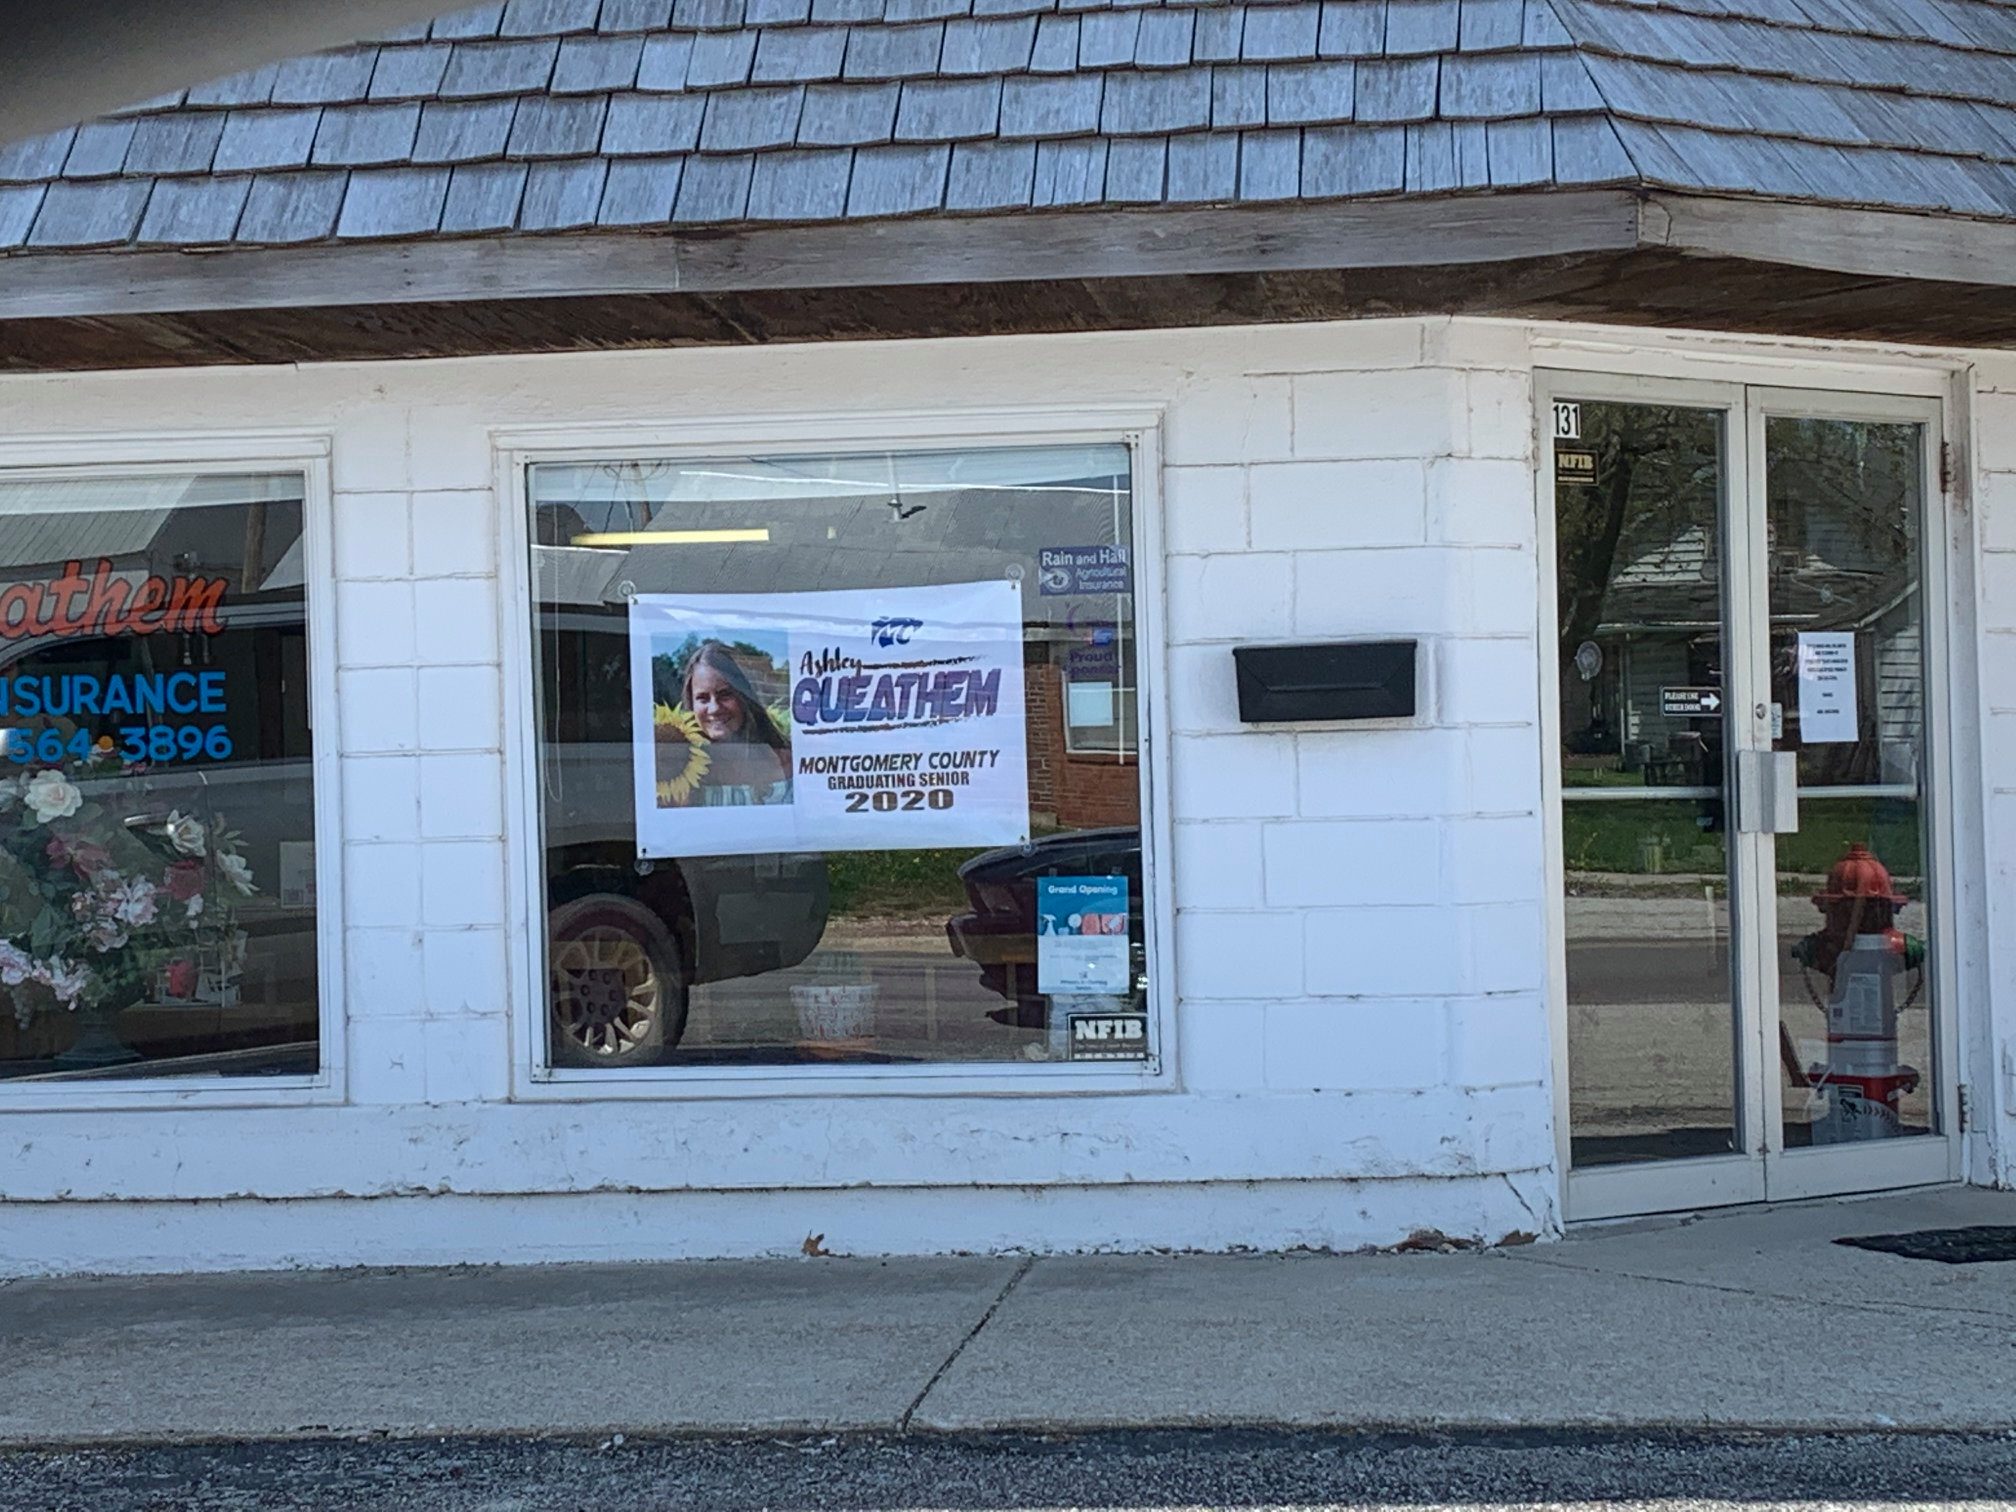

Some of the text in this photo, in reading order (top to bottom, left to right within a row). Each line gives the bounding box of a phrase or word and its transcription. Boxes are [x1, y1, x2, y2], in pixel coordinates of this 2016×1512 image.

[1553, 404, 1579, 436] 131
[1558, 453, 1593, 469] NFIB
[1042, 547, 1127, 566] Rain and Hail
[1075, 567, 1127, 579] Agricultural
[1079, 579, 1124, 590] Insurance
[0, 557, 228, 638] athem
[799, 647, 863, 677] Ashley
[1062, 664, 1121, 679] ponsor
[792, 668, 1001, 725] QUEATHEM
[799, 749, 1001, 775] MONTGOMERY COUNTY
[828, 770, 969, 790] GRADUATING SENIOR
[845, 789, 954, 813] 2020
[1048, 884, 1118, 896] Grand Opening
[1075, 1019, 1143, 1040] NFIB
